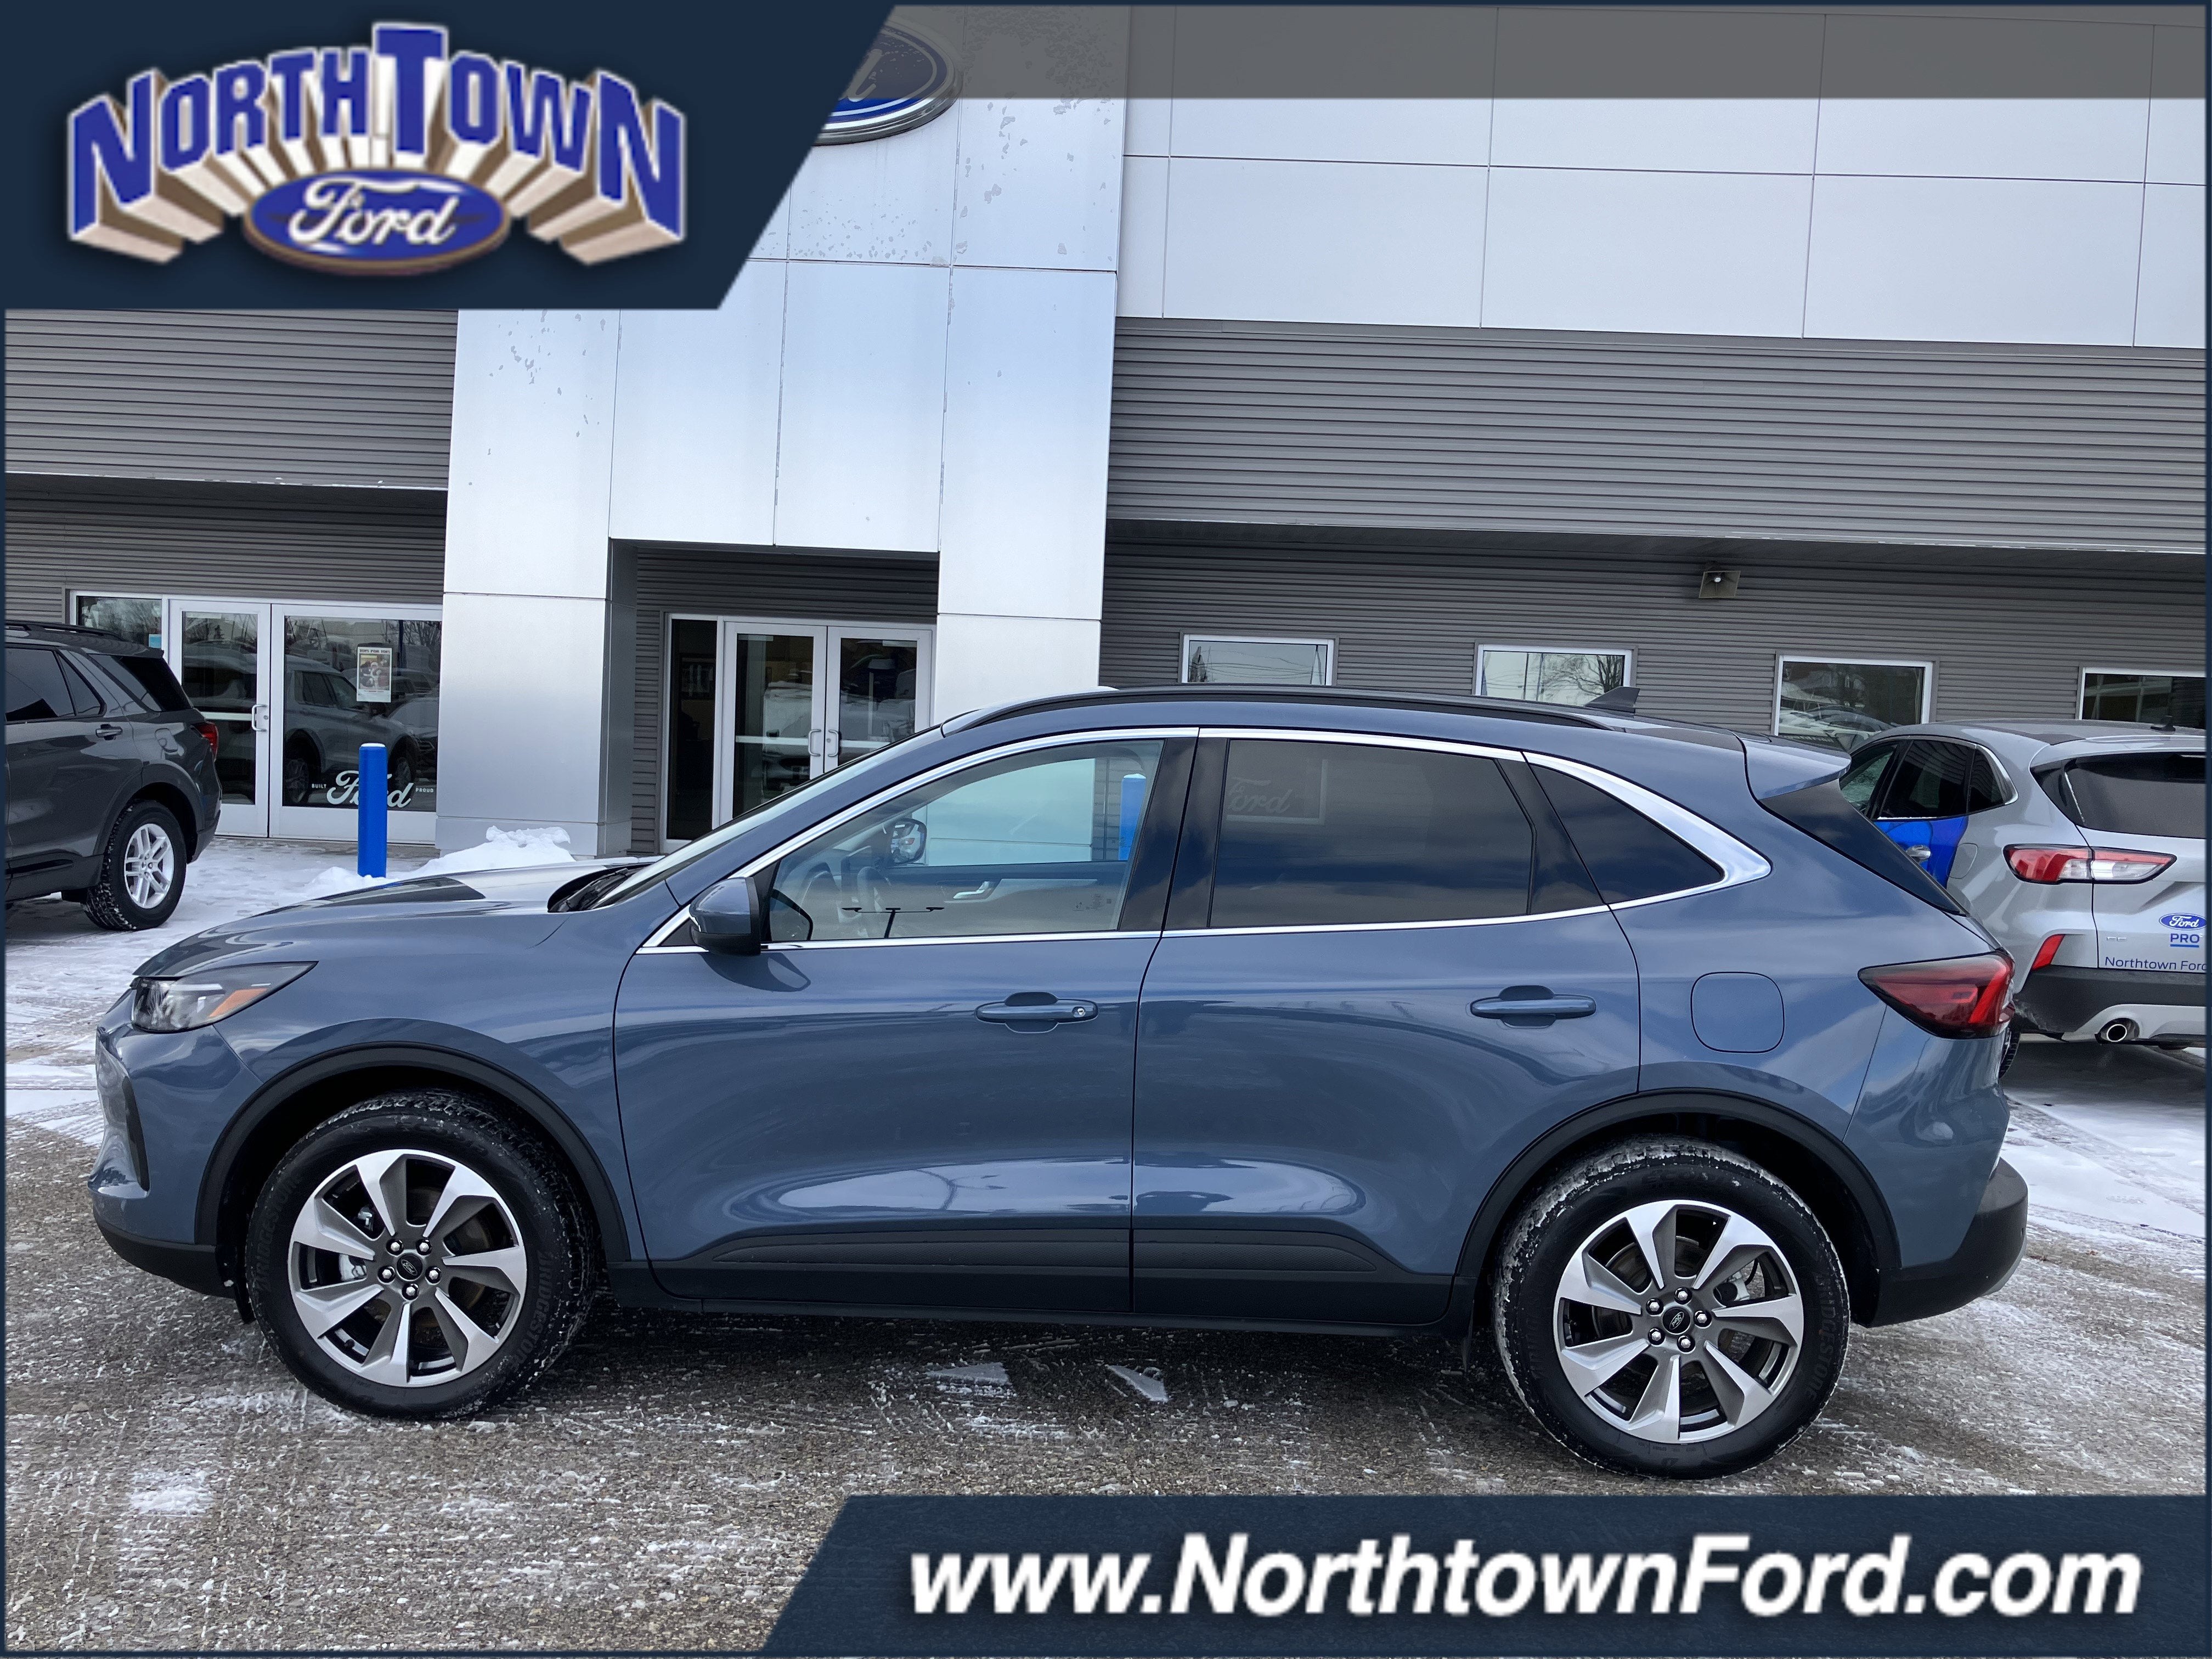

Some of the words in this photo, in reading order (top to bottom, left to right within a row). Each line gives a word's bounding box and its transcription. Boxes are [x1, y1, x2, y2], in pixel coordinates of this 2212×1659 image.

[2169, 915, 2200, 928] Ford
[2170, 933, 2200, 943] PRO
[2105, 957, 2177, 970] Northtown
